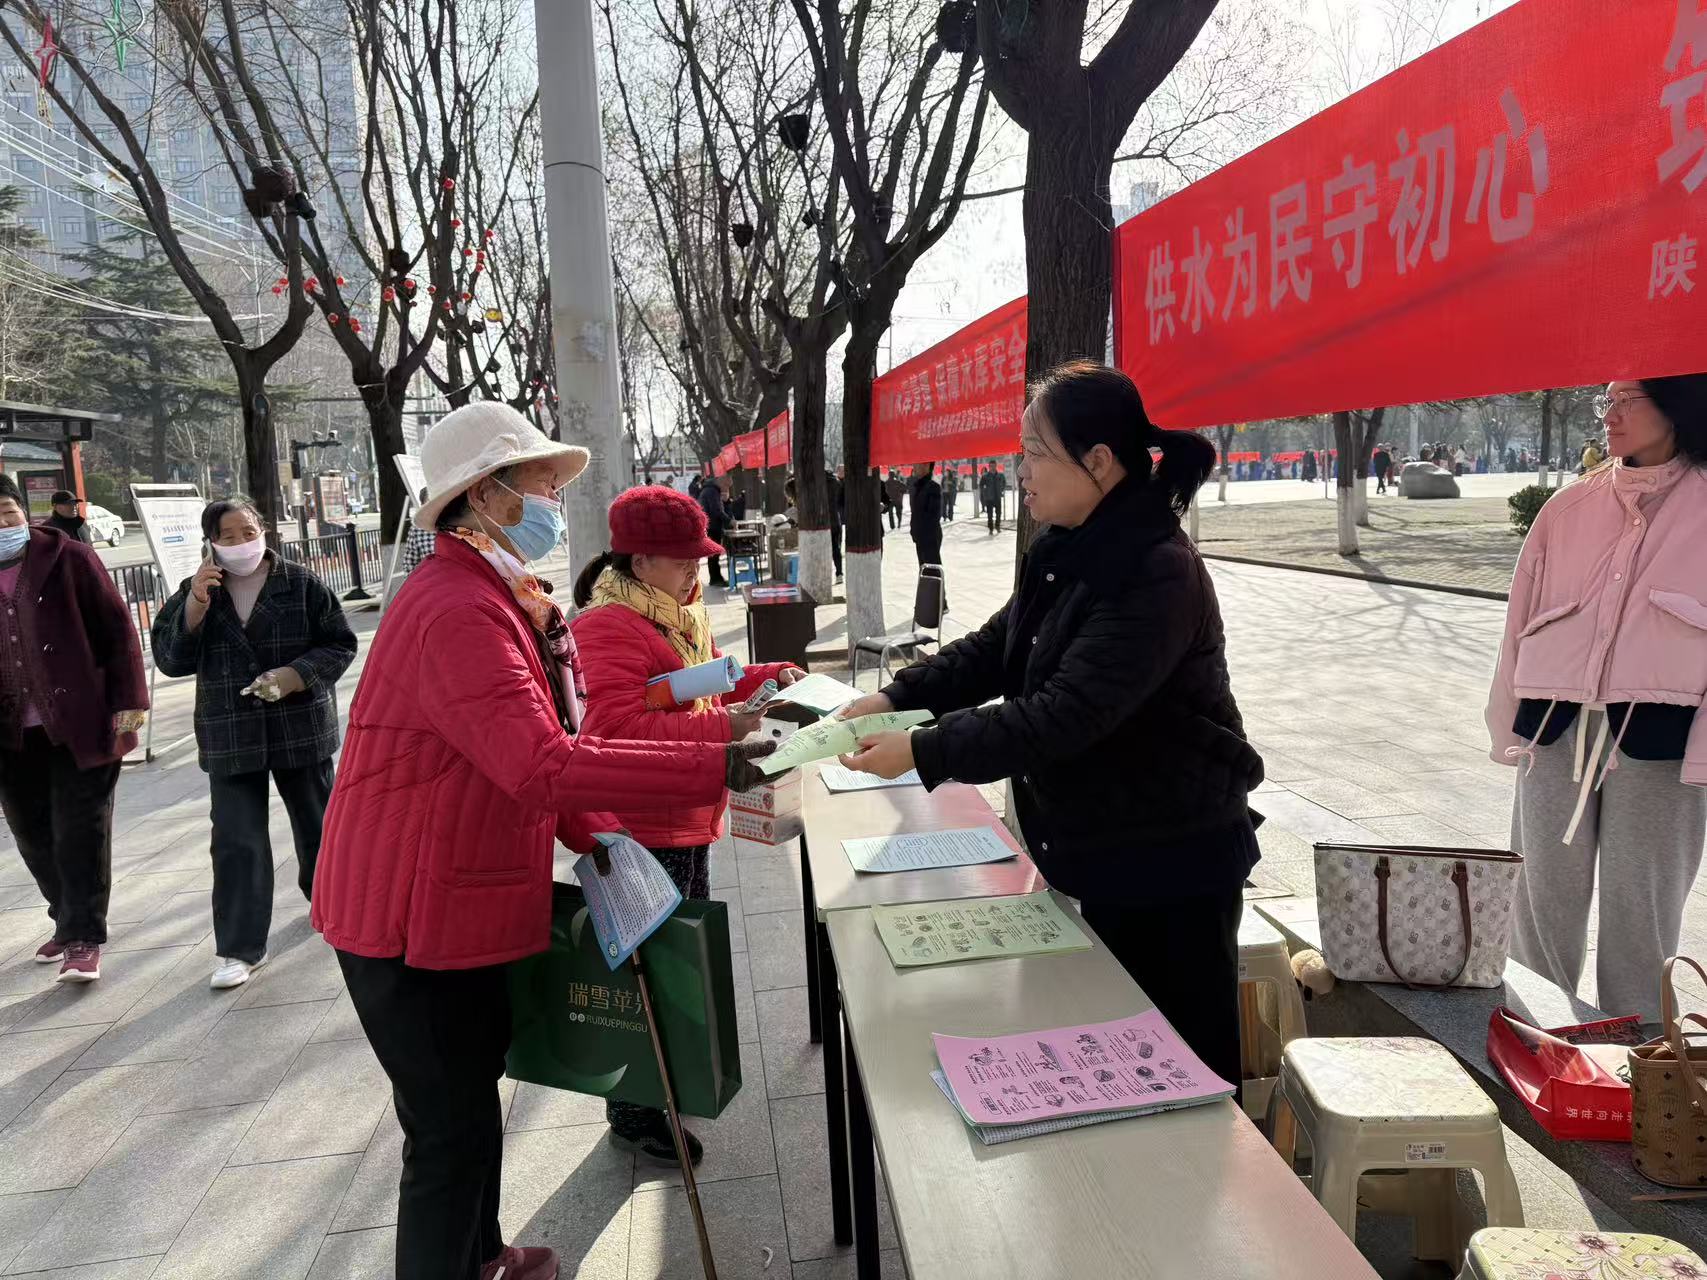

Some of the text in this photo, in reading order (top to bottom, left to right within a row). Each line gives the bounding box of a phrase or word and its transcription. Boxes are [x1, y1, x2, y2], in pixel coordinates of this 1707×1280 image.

[1144, 87, 1549, 346] 供水为民守初心
[1648, 232, 1697, 300] 陕
